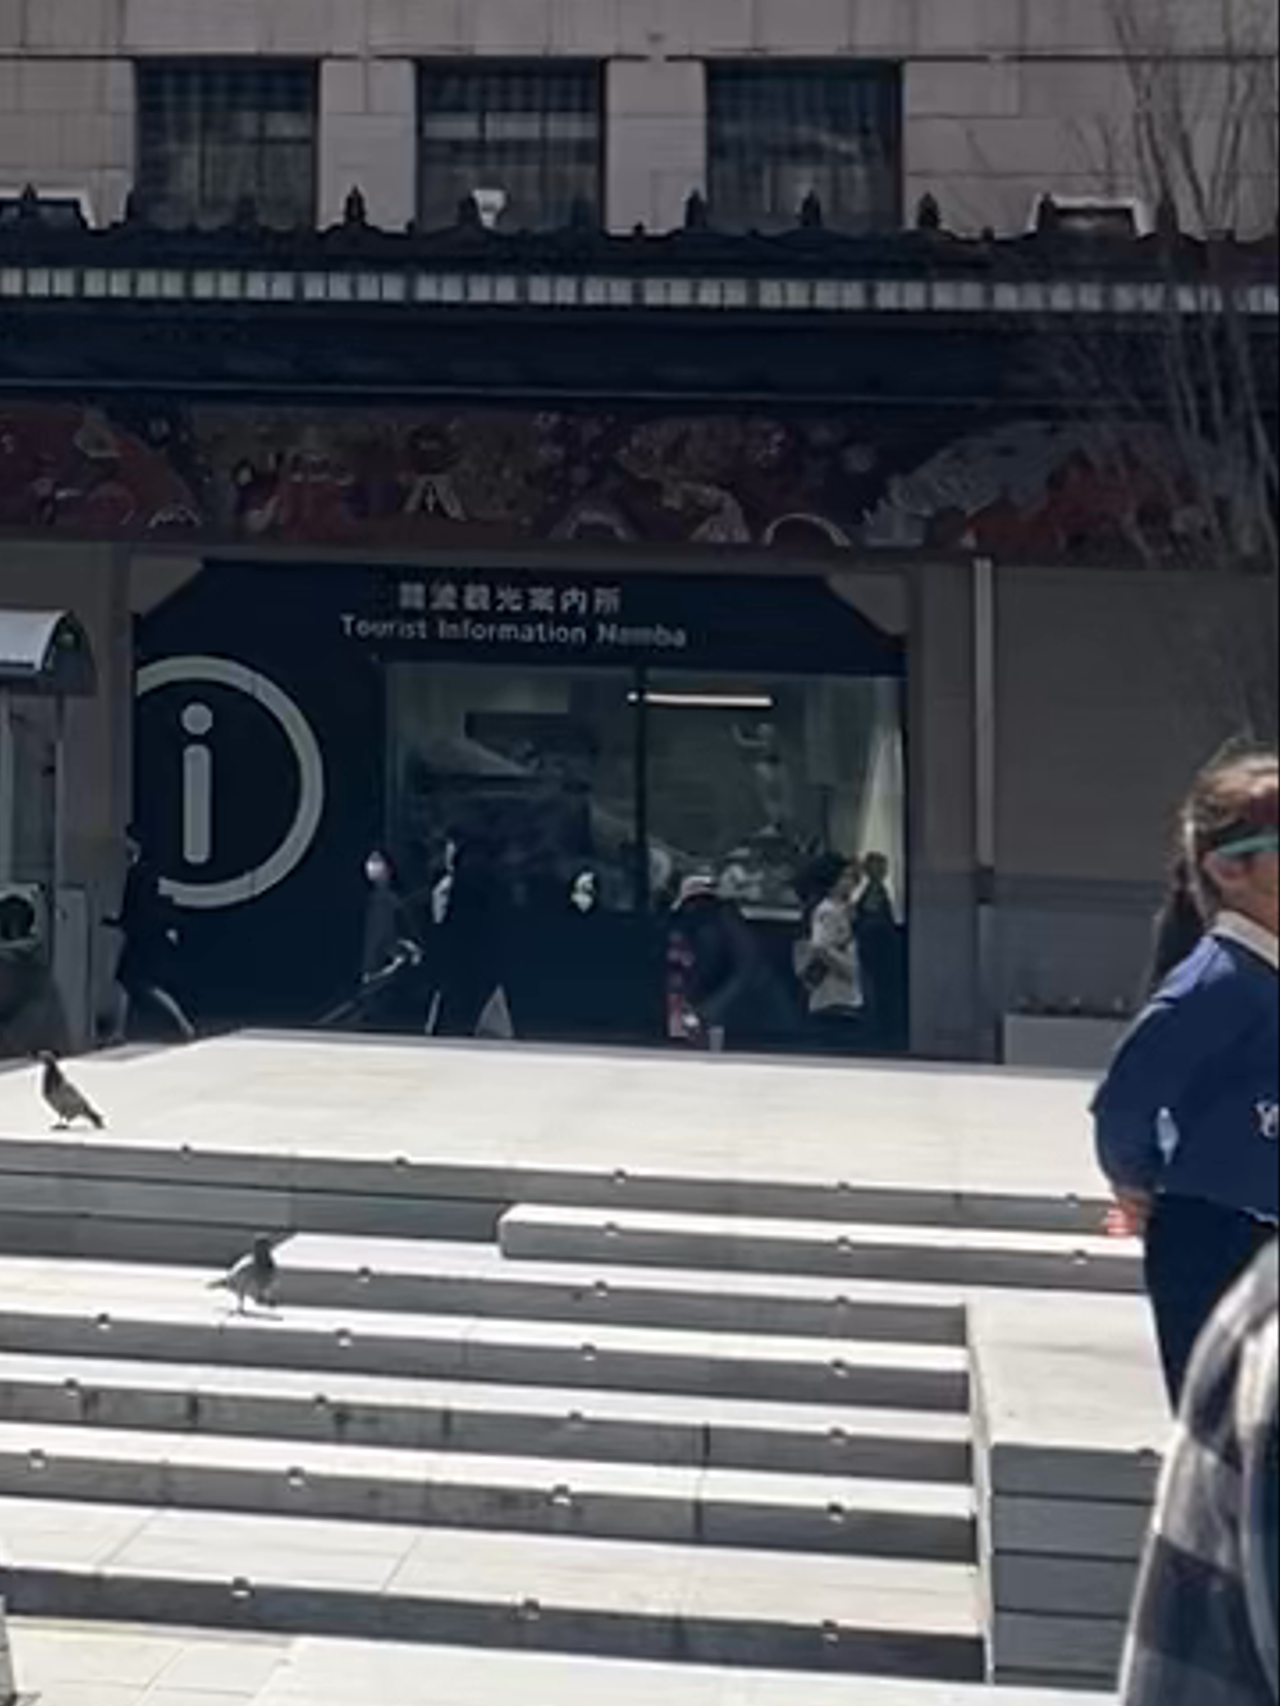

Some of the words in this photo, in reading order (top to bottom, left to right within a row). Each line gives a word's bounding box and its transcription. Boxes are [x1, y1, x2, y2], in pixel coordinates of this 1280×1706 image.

[340, 613, 428, 640] Tourist
[438, 617, 588, 645] Information
[596, 622, 687, 648] Namba
